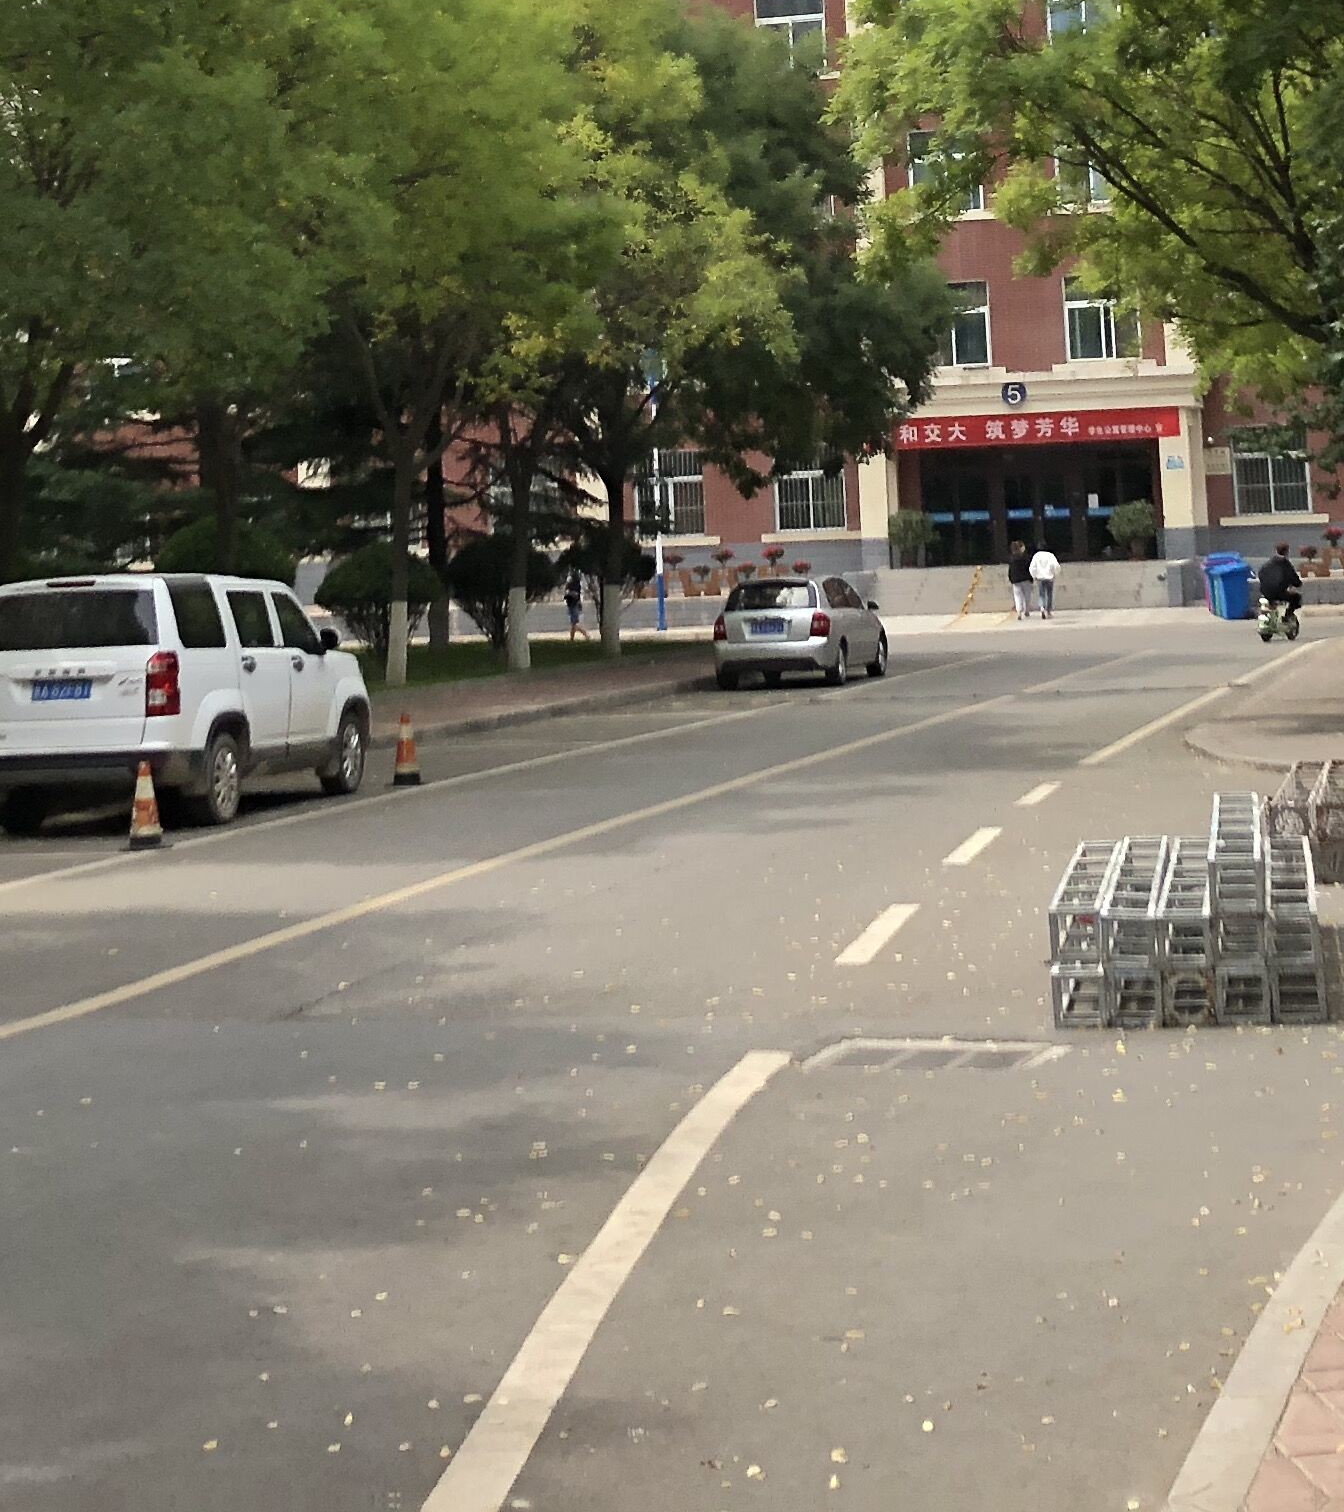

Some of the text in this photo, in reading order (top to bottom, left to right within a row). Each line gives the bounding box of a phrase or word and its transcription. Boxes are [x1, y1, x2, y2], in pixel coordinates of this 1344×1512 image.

[1007, 385, 1022, 405] 5
[985, 416, 1080, 441] 筑梦芳华
